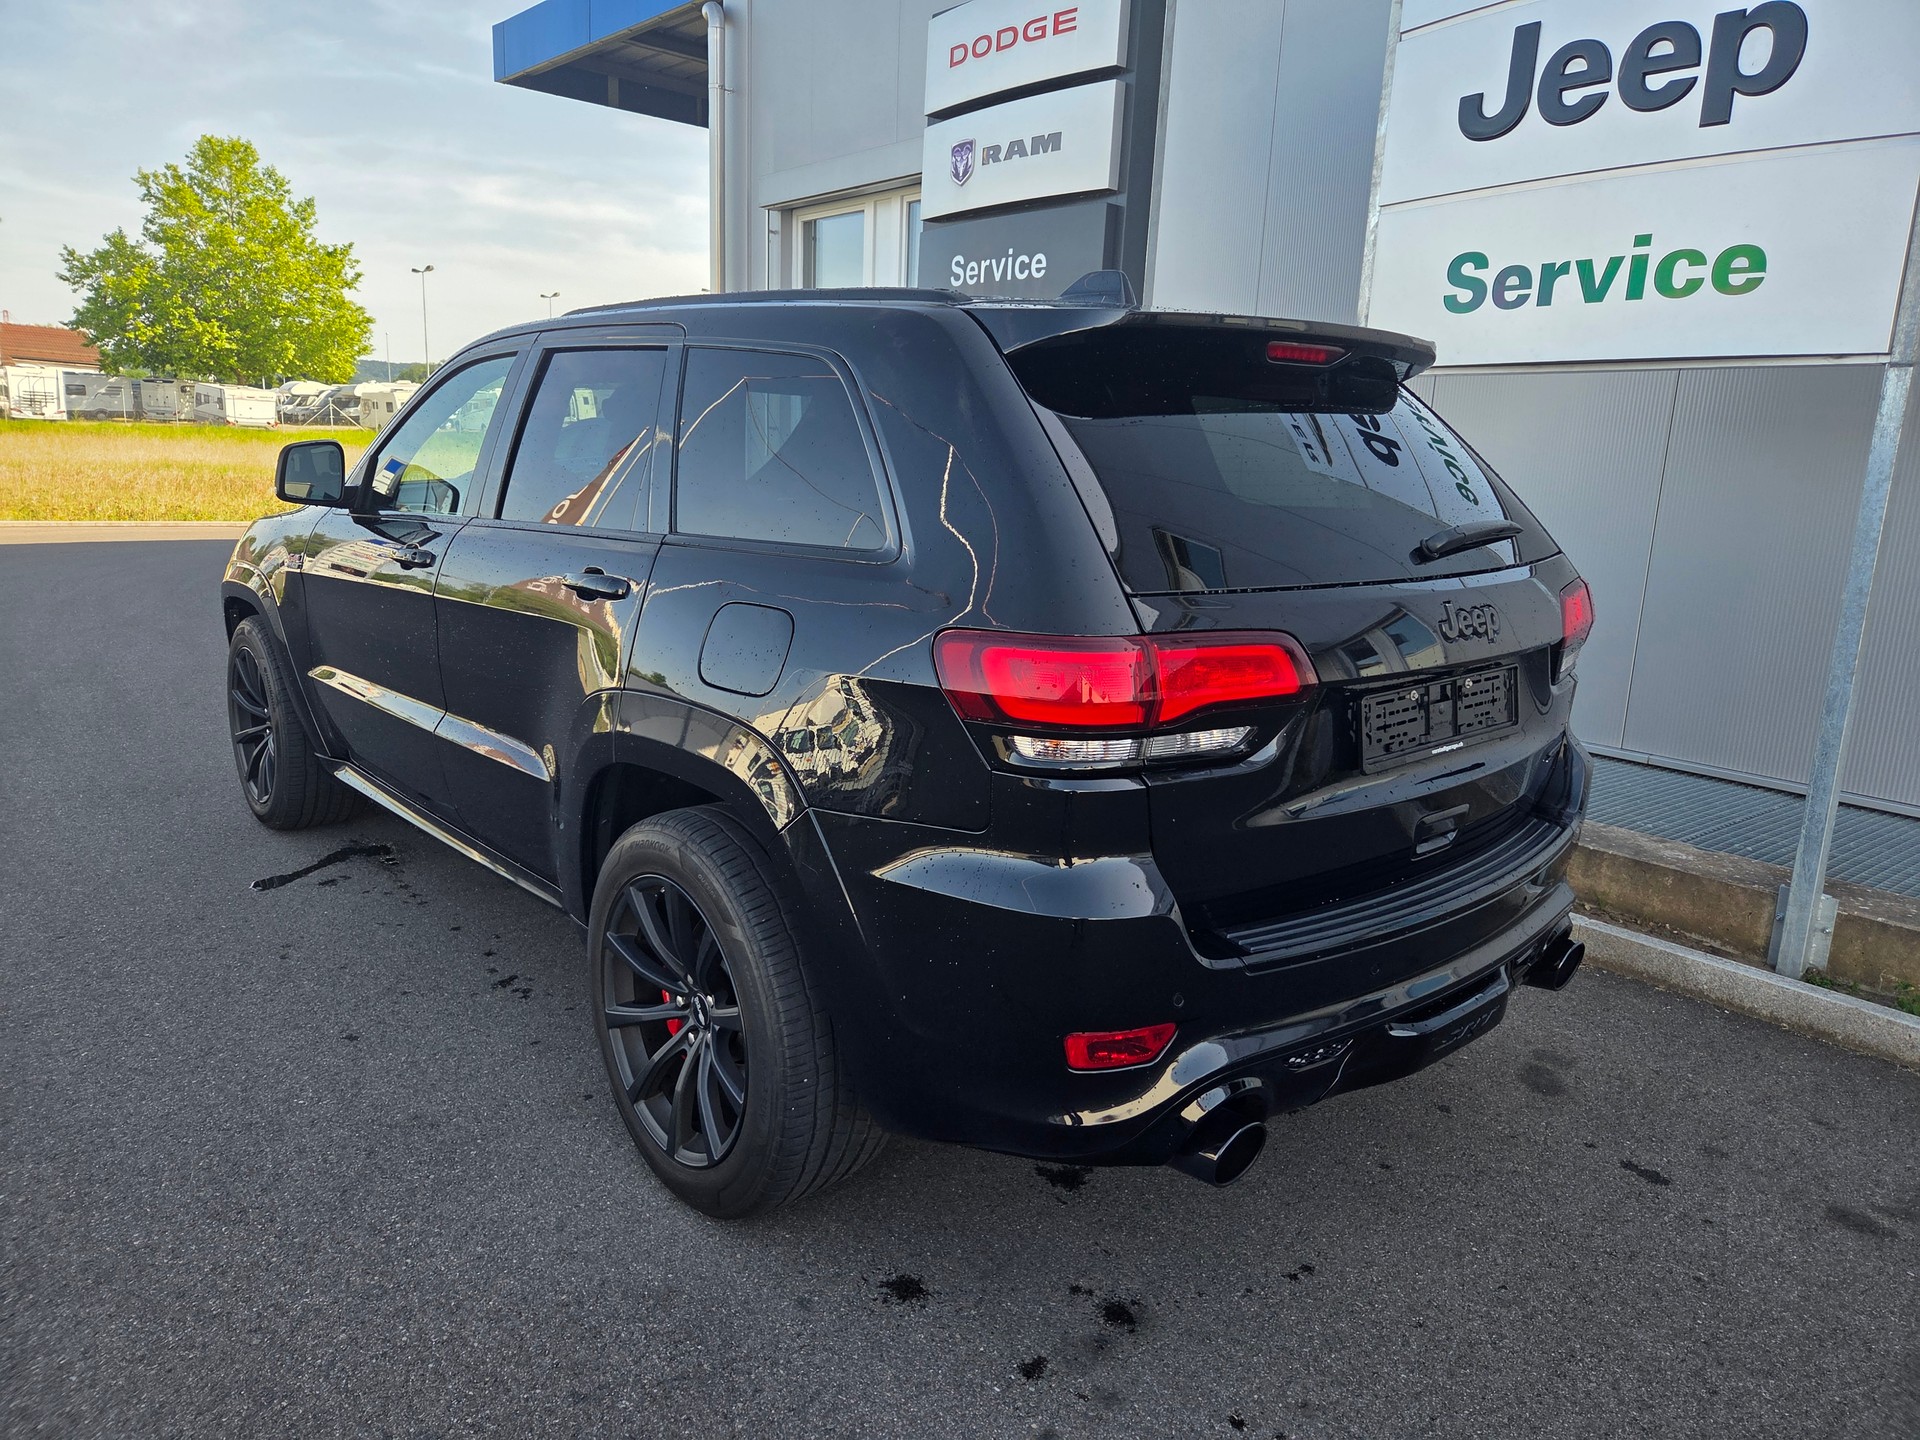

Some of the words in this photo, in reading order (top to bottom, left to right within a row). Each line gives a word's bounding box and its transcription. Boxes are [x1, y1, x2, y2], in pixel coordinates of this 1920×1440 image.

[949, 7, 1078, 69] DODGE
[1458, 0, 1808, 142] Jeep
[981, 131, 1062, 166] RAM
[950, 248, 1047, 287] Service
[1443, 233, 1768, 314] Service
[1437, 600, 1500, 644] Jeep
